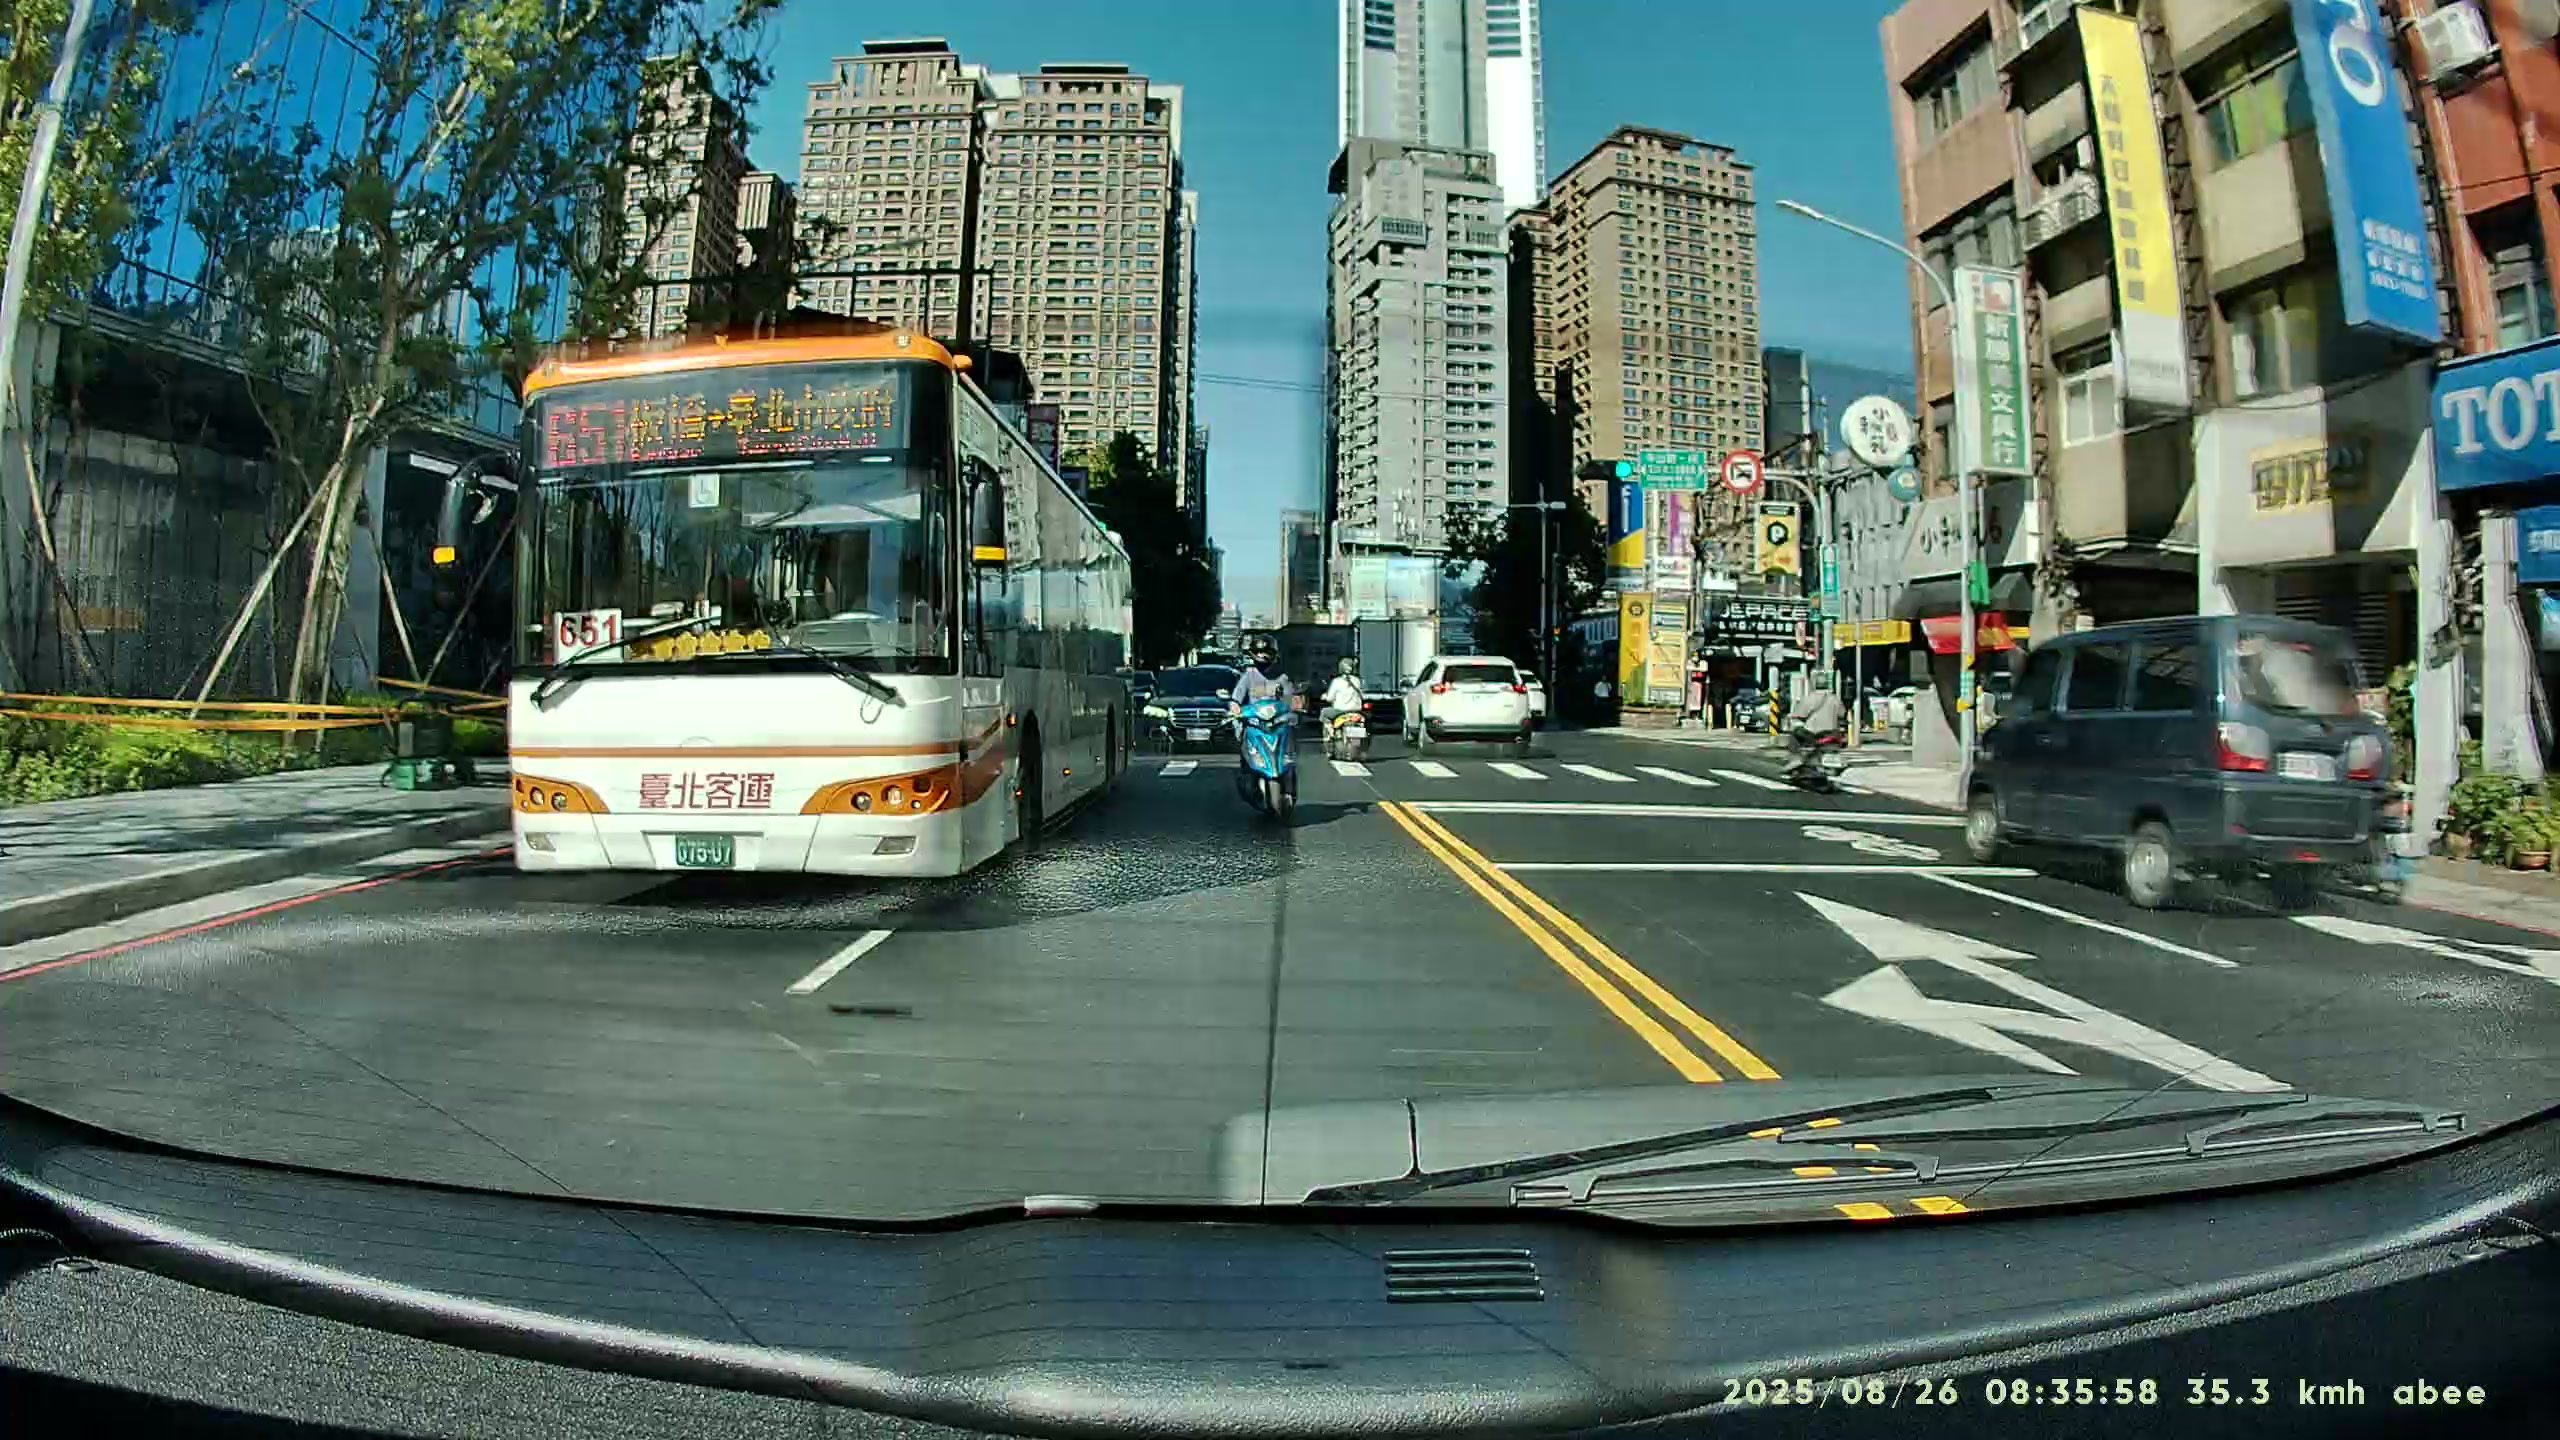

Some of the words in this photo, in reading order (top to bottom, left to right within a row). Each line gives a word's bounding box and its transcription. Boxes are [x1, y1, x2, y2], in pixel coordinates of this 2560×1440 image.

[547, 402, 626, 468] 651
[560, 614, 617, 648] 651
[638, 771, 775, 809] 臺北客運
